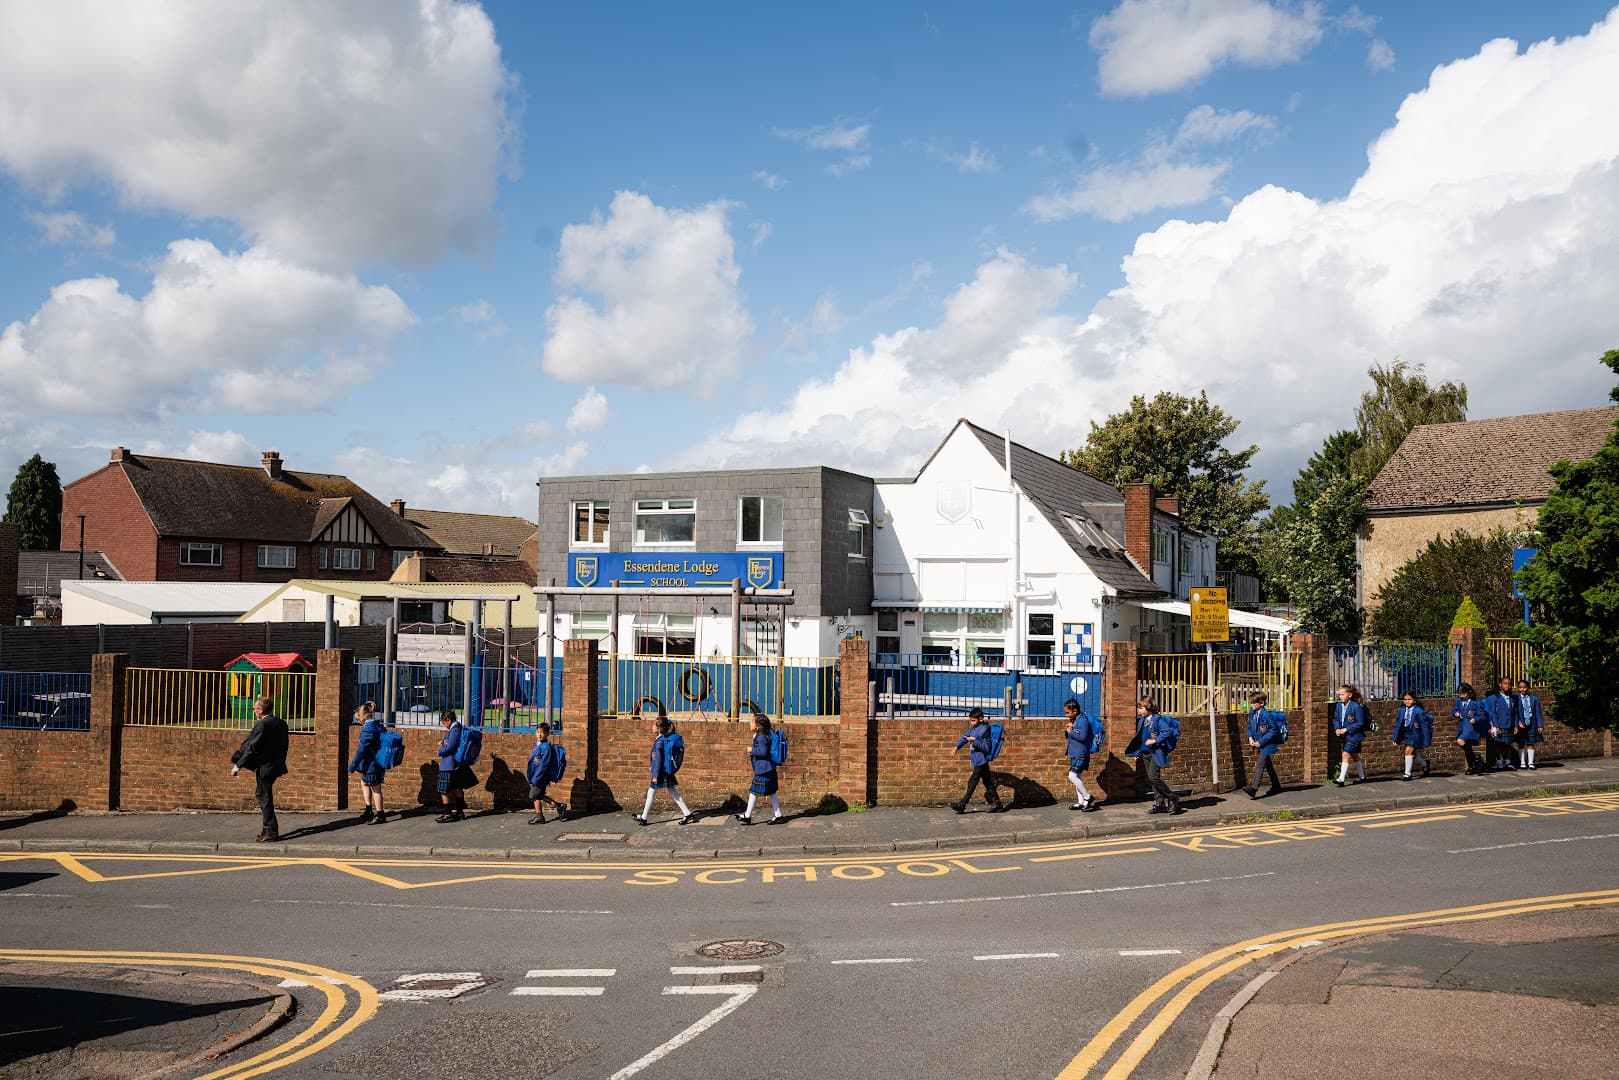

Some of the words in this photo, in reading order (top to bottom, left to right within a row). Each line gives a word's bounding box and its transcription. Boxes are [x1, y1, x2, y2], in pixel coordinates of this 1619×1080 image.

[624, 560, 680, 573] Essendene
[683, 560, 719, 575] Lodge
[650, 578, 688, 587] SCHOOL
[624, 860, 1022, 886] SCHOOL
[1160, 825, 1345, 852] KEEP
